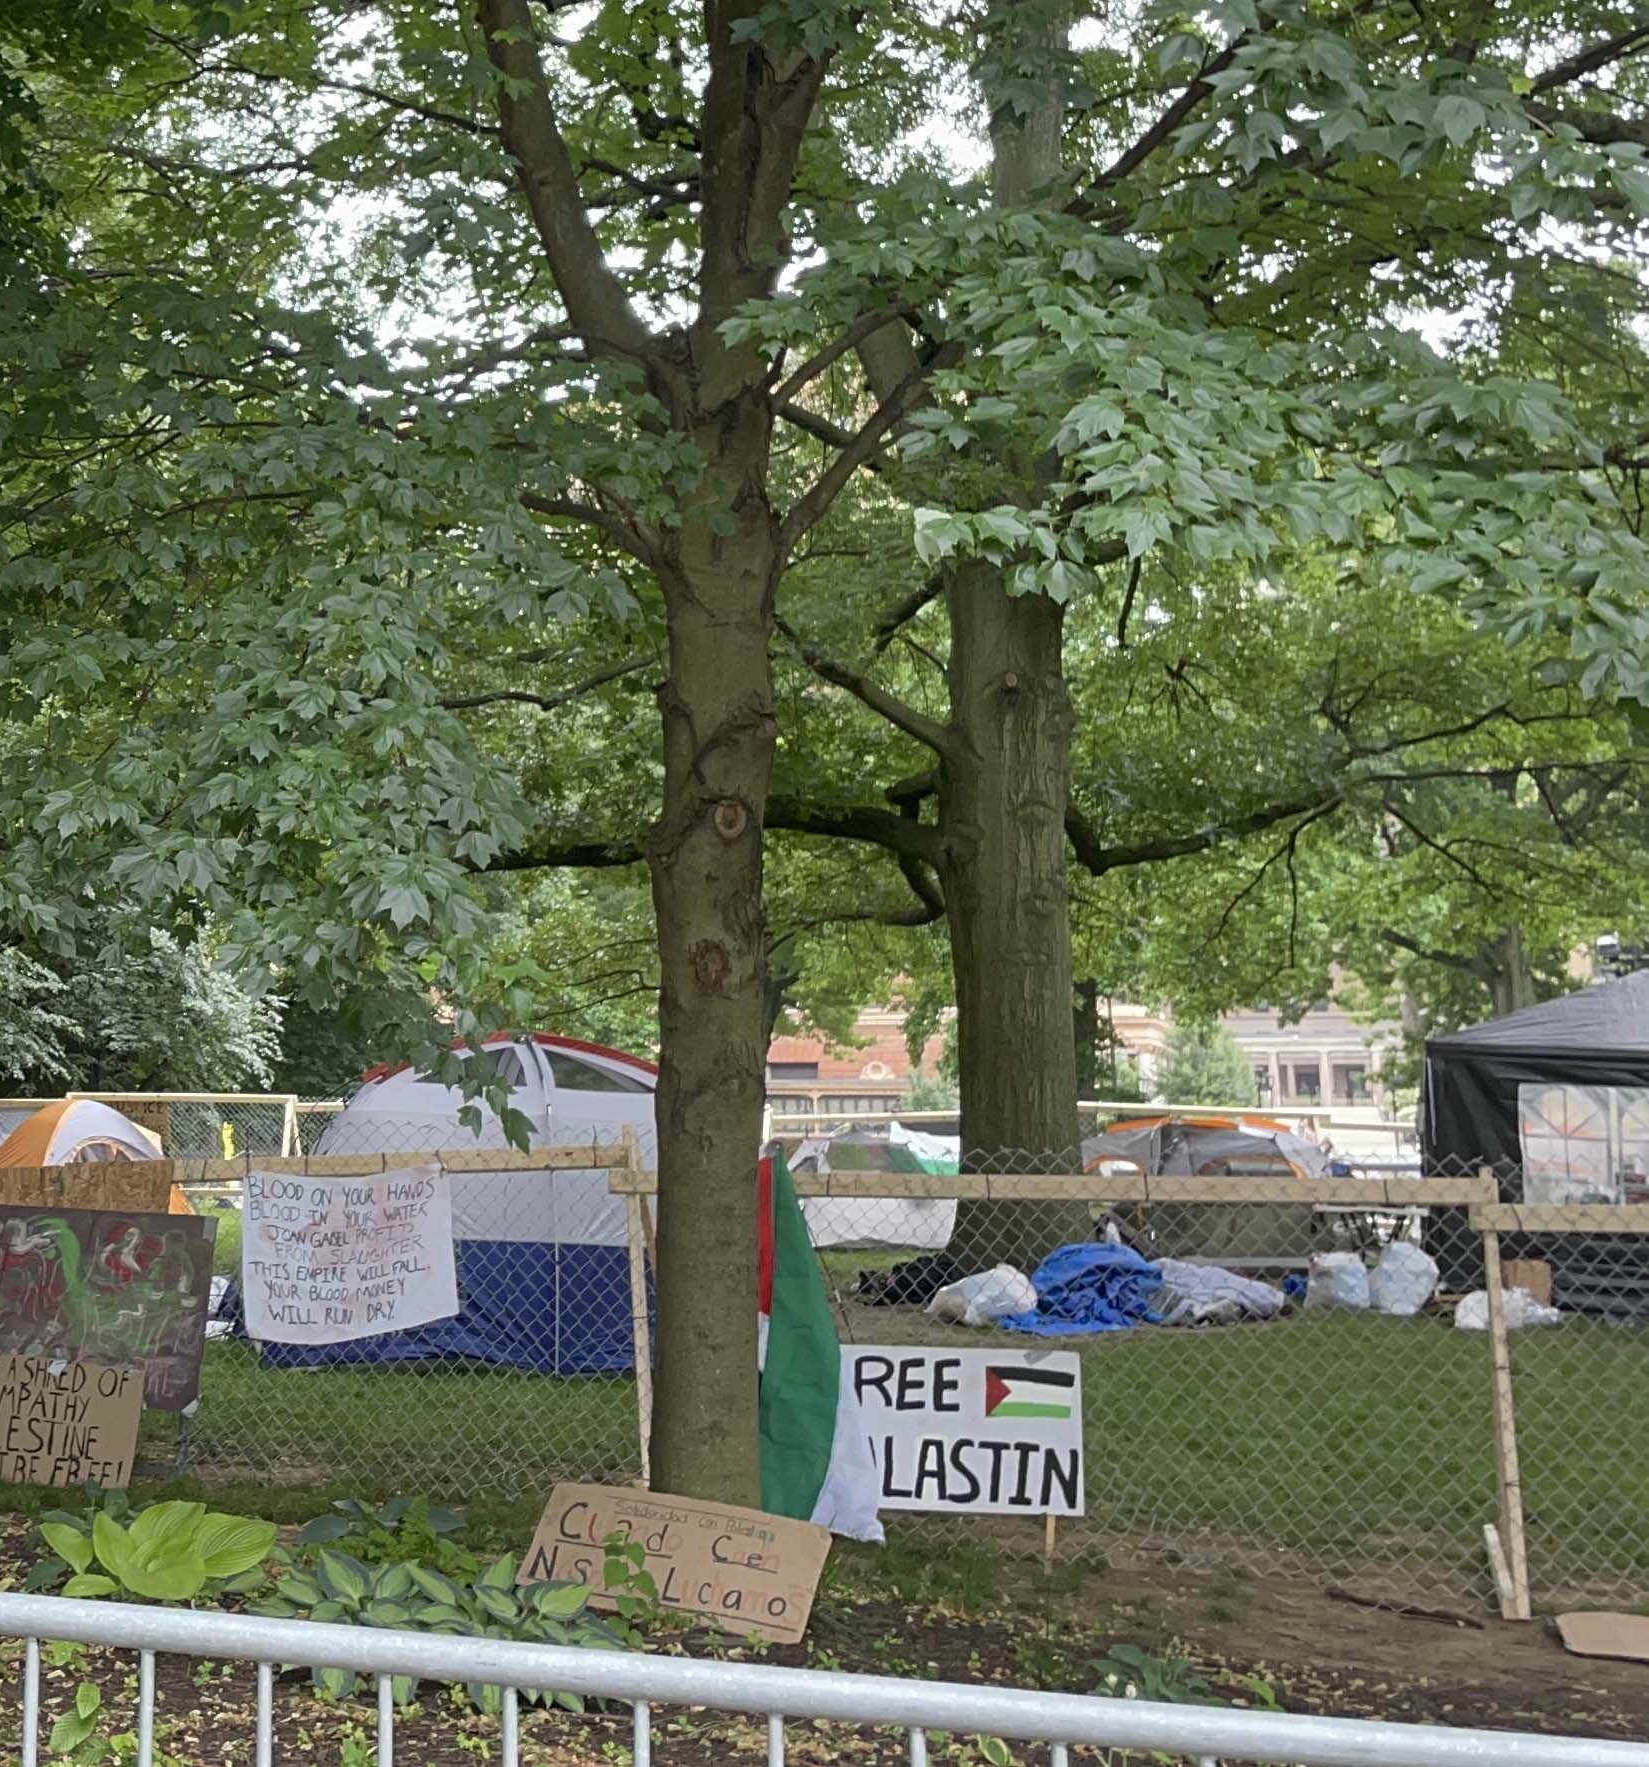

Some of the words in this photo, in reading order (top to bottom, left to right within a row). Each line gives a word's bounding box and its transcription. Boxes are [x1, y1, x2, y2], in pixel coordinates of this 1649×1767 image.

[248, 1175, 304, 1200] BLOOD
[311, 1187, 334, 1206] ON
[342, 1187, 376, 1206] YOUR
[387, 1177, 435, 1200] HANDS
[250, 1200, 300, 1221] BLOOD
[307, 1209, 329, 1226] IN
[343, 1210, 376, 1228] YOUR
[383, 1202, 428, 1223] WATER
[275, 1243, 319, 1263] FROM
[330, 1234, 424, 1265] SLAUGHTER
[310, 1230, 349, 1248] GABEL
[249, 1261, 290, 1280] THIS
[296, 1265, 346, 1283] EMPIRE
[356, 1264, 389, 1282] WILL
[264, 1281, 301, 1299] YOUR
[309, 1285, 350, 1302] BLOOD
[356, 1277, 405, 1302] MONEY
[268, 1303, 319, 1325] WILL
[325, 1307, 353, 1325] RUN
[8, 1357, 16, 1382] A
[98, 1368, 129, 1398] OF
[854, 1355, 961, 1411] REE
[13, 1455, 40, 1483] BE
[50, 1456, 123, 1488] FREE!
[868, 1436, 1079, 1509] LASTIN
